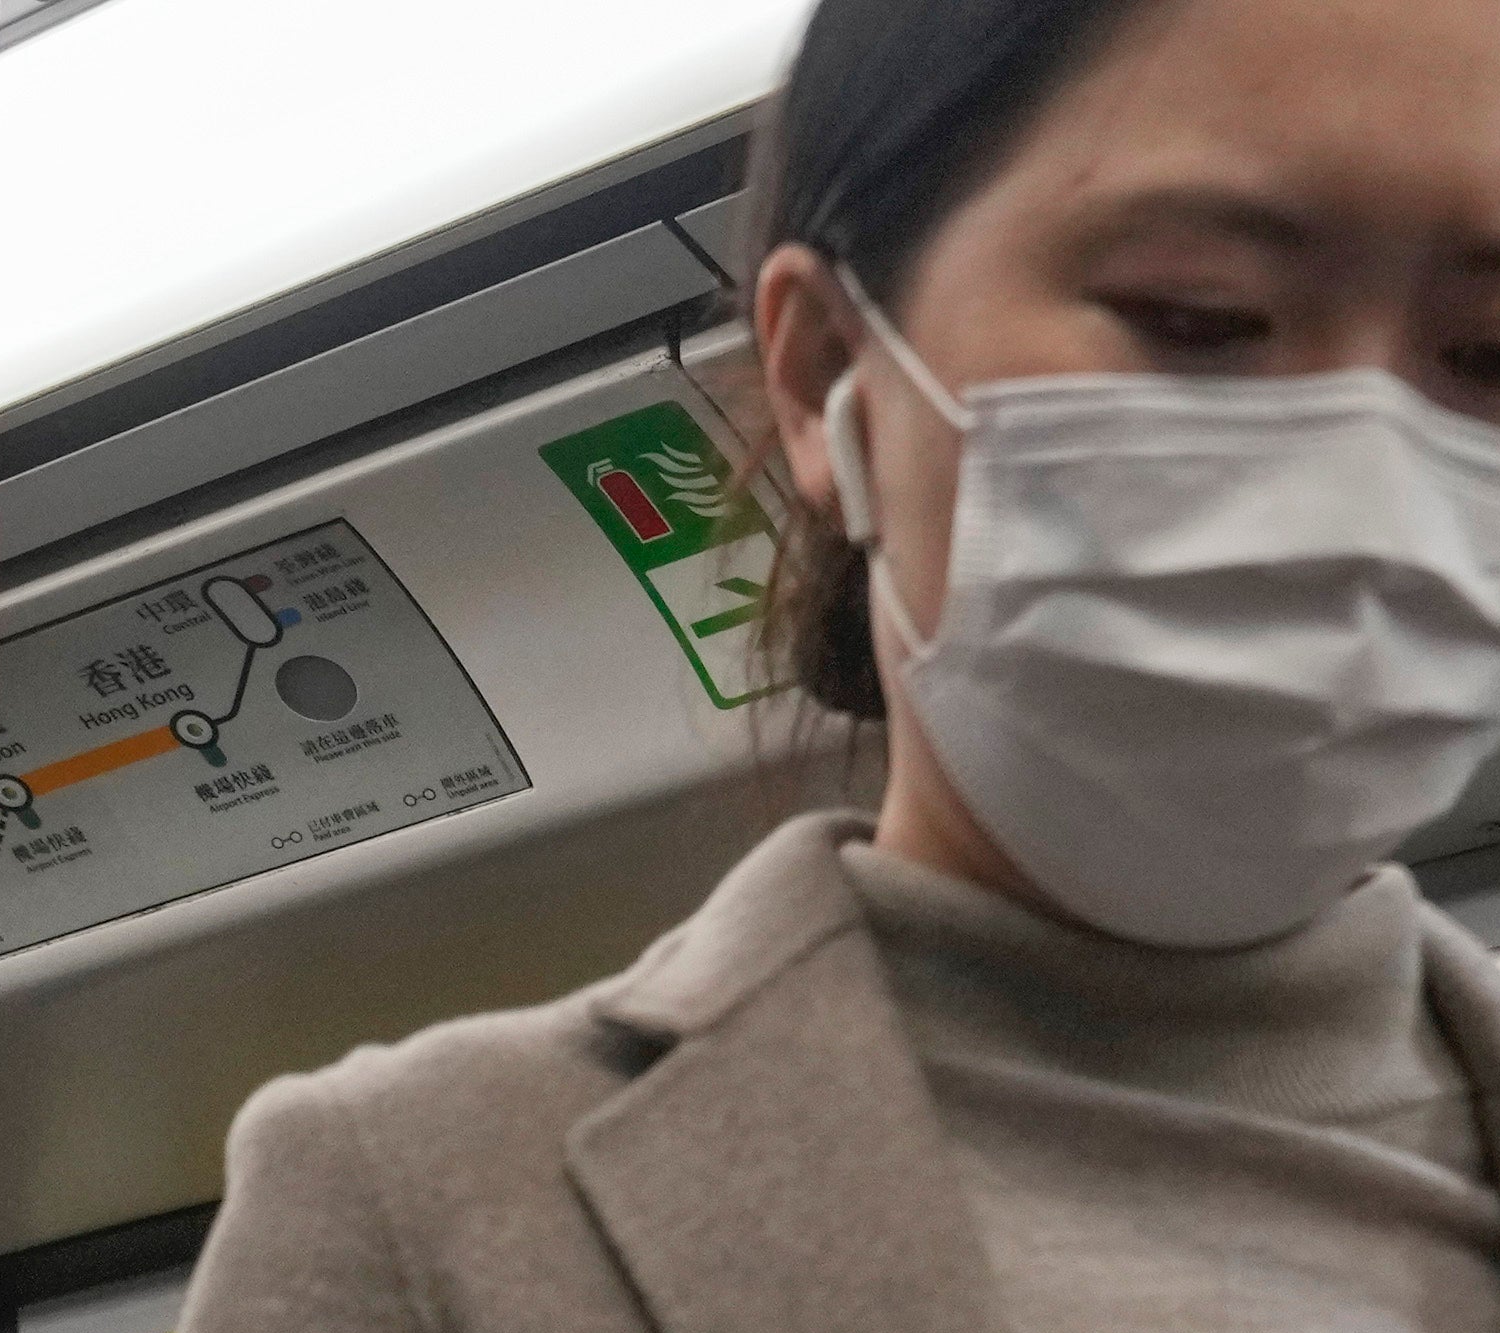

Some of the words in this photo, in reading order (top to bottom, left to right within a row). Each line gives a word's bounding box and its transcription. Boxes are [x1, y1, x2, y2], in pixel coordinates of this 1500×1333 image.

[136, 589, 198, 623] 中環
[162, 611, 212, 635] Central
[78, 644, 171, 698] 香港
[79, 702, 140, 729] Hong
[135, 683, 195, 711] Kong
[480, 778, 499, 791] area
[209, 795, 244, 814] Airport
[243, 785, 281, 805] Express
[312, 830, 332, 843] Paid
[333, 825, 352, 838] area
